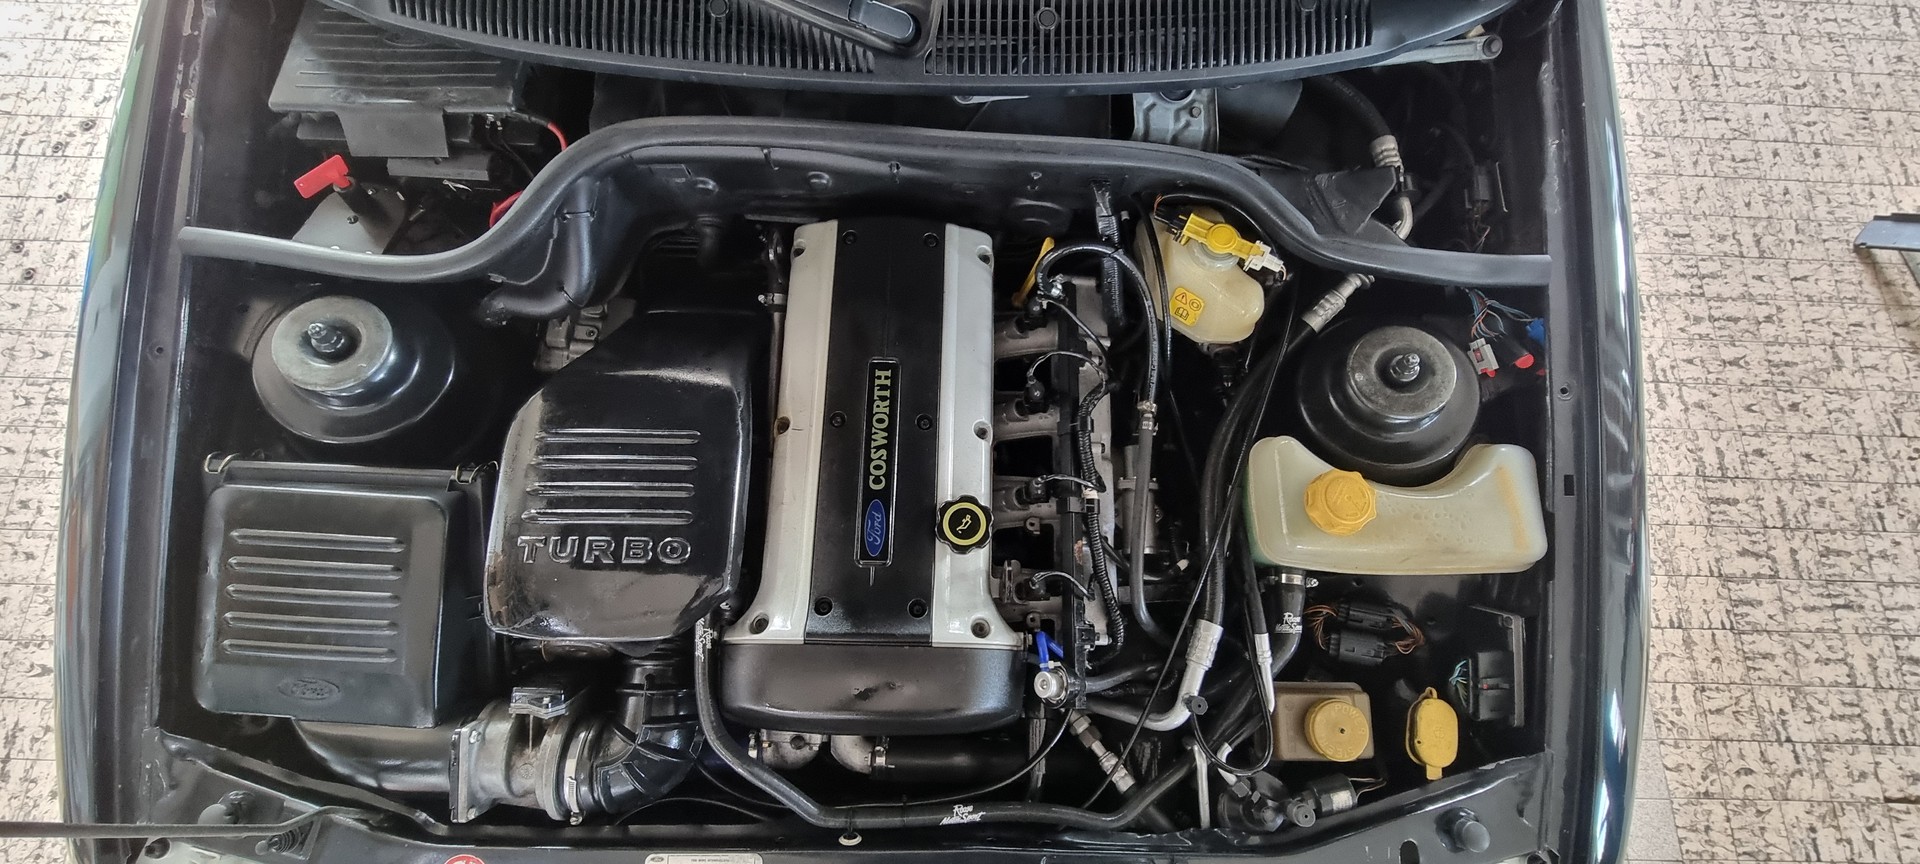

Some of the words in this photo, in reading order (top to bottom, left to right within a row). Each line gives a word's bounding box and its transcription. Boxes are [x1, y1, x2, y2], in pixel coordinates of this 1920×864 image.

[868, 368, 893, 491] COSWORTH
[517, 535, 692, 564] TURBO
[1334, 703, 1366, 735] POWER
